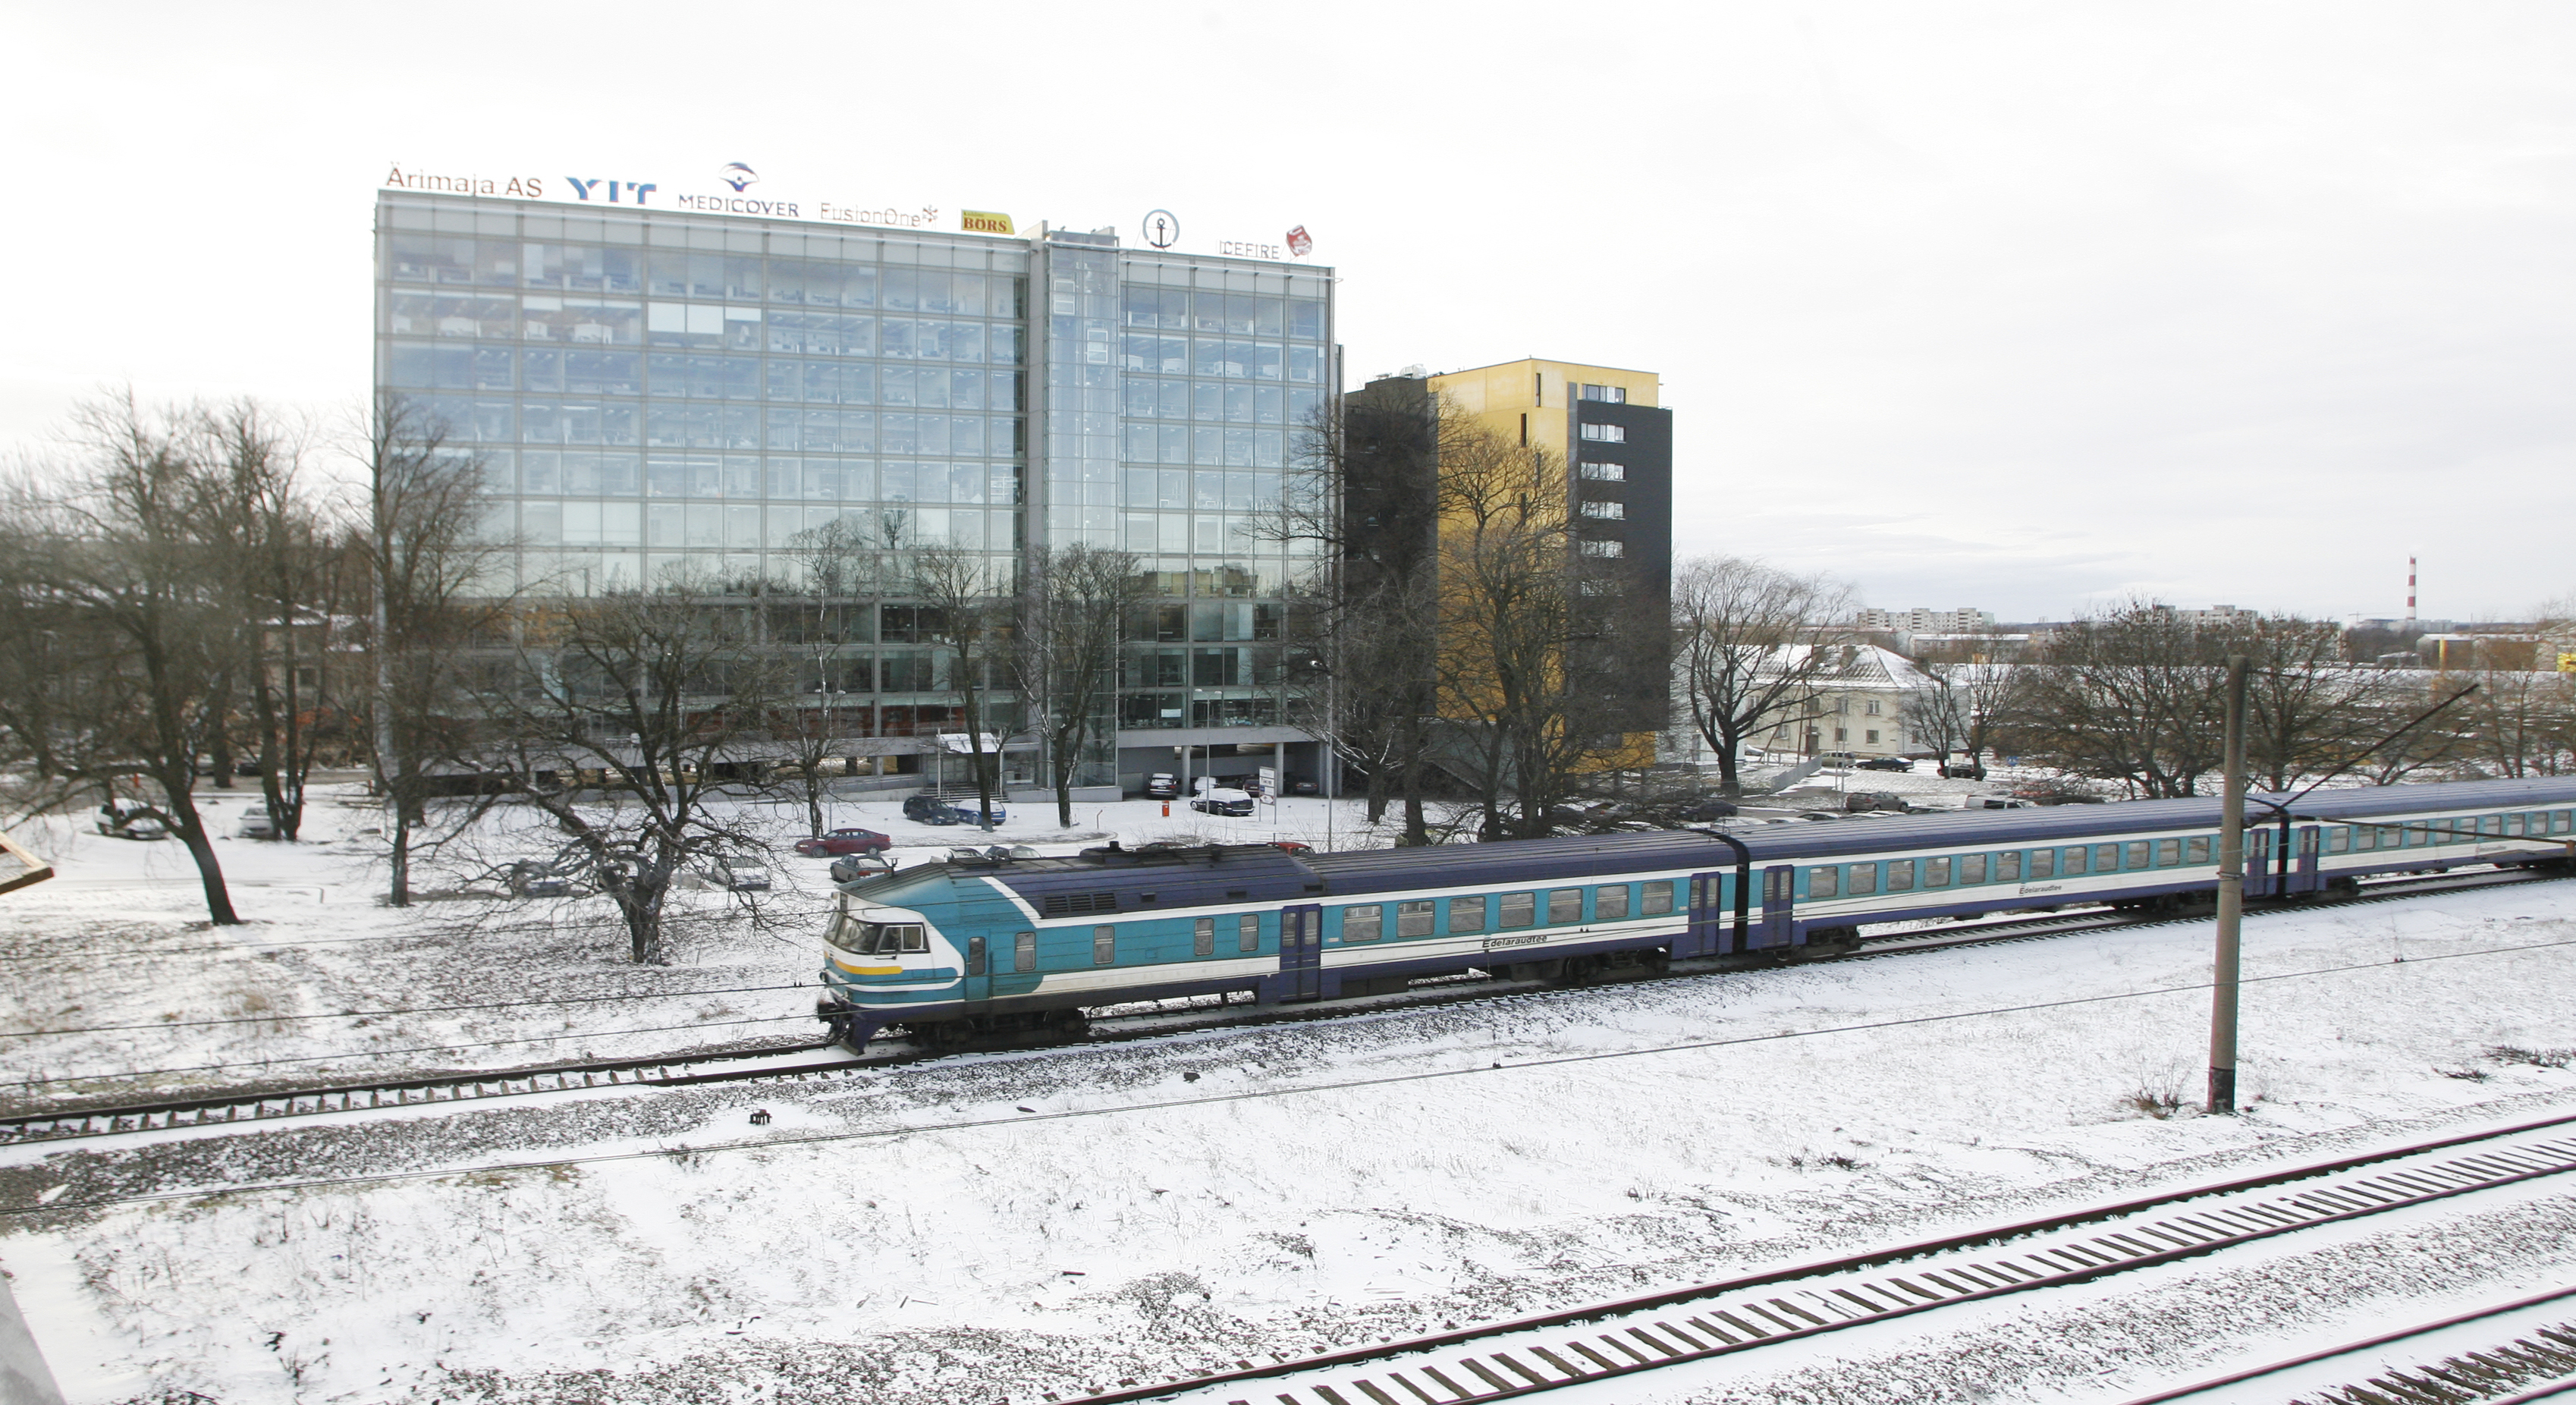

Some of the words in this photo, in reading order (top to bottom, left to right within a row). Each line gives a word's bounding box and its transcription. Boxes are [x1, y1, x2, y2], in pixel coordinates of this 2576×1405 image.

[386, 160, 495, 196] Ärimaja
[506, 176, 542, 198] AS
[564, 177, 657, 205] YIT
[679, 194, 800, 217] MEDICOVER
[821, 202, 921, 227] FusionOne
[1220, 240, 1280, 259] ICEFIRE
[1482, 935, 1547, 948] Edelaraudtee
